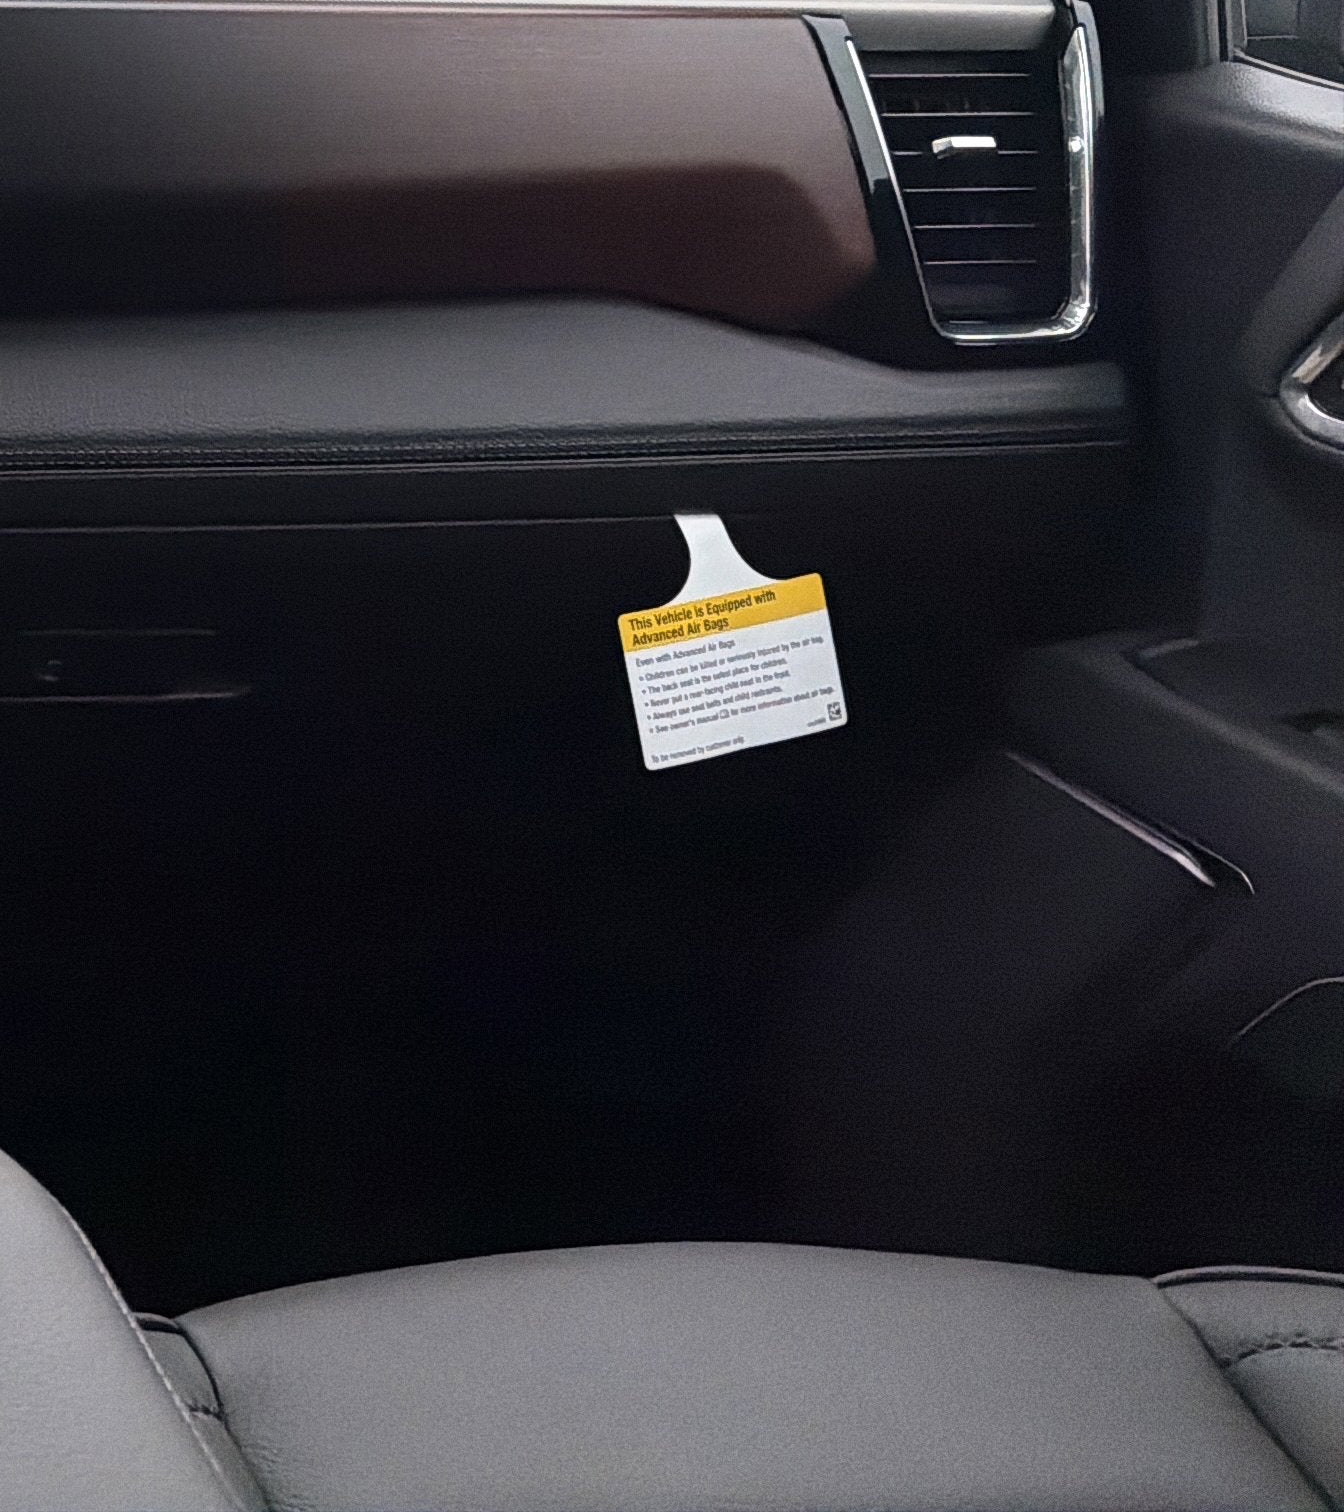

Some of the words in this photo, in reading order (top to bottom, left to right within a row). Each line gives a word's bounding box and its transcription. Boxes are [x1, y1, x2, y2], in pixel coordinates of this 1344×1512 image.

[630, 616, 652, 631] This
[656, 607, 693, 625] Vehicle
[706, 594, 752, 617] Equipped
[754, 589, 776, 604] with
[632, 625, 684, 647] Advanced
[686, 621, 702, 635] Air
[704, 615, 729, 633] Bags
[636, 656, 654, 667] Even
[656, 652, 671, 663] with
[672, 645, 706, 659] Advanced
[708, 642, 717, 651] Air
[718, 638, 736, 651] Bags
